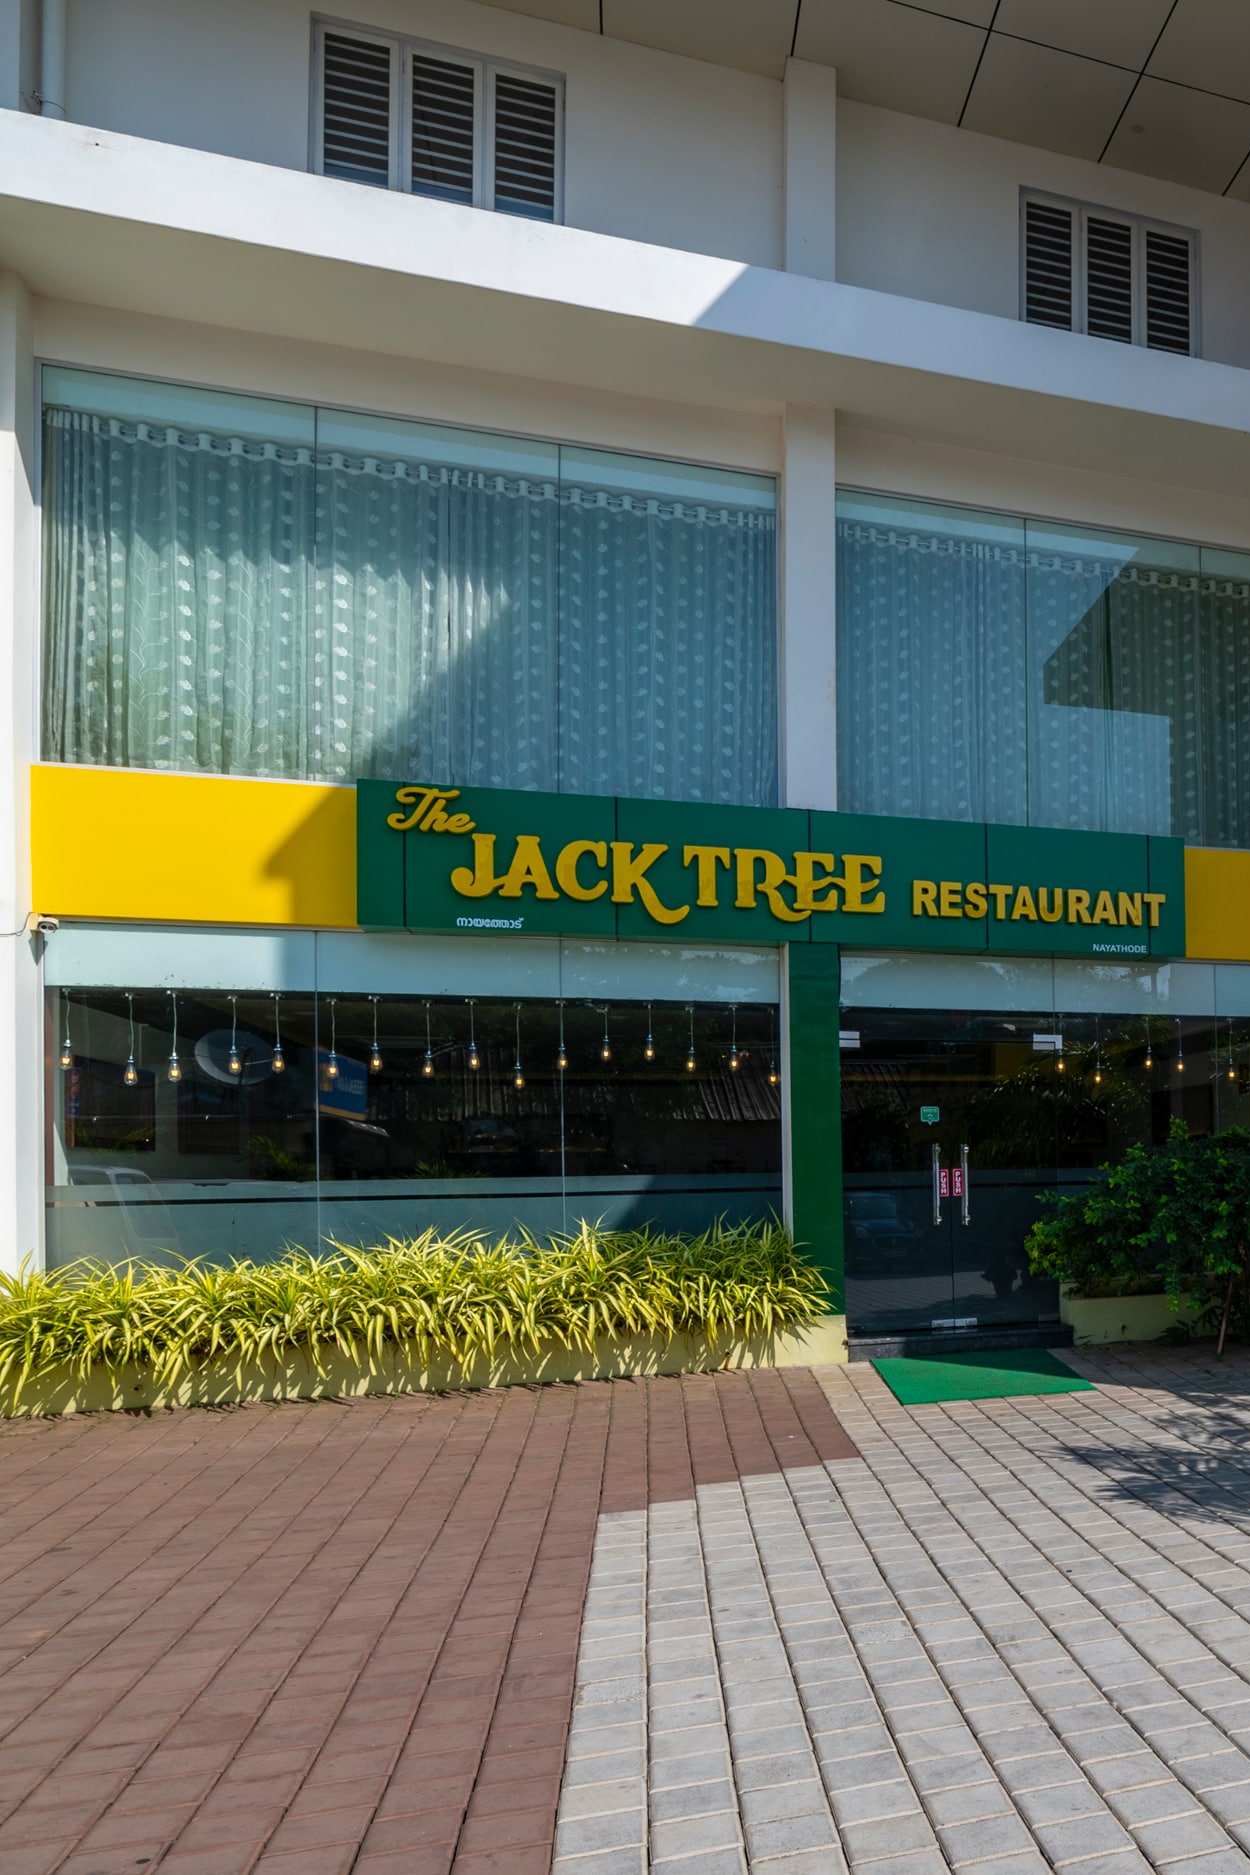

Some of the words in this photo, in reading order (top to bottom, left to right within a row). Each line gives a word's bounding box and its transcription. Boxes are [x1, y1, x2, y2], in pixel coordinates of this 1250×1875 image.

[387, 786, 476, 834] The
[451, 833, 690, 924] JACK
[683, 845, 886, 922] TREE
[912, 880, 1166, 927] RESTAURANT
[456, 917, 525, 929] നായത്തോട്
[1092, 943, 1147, 953] NAYATHODE
